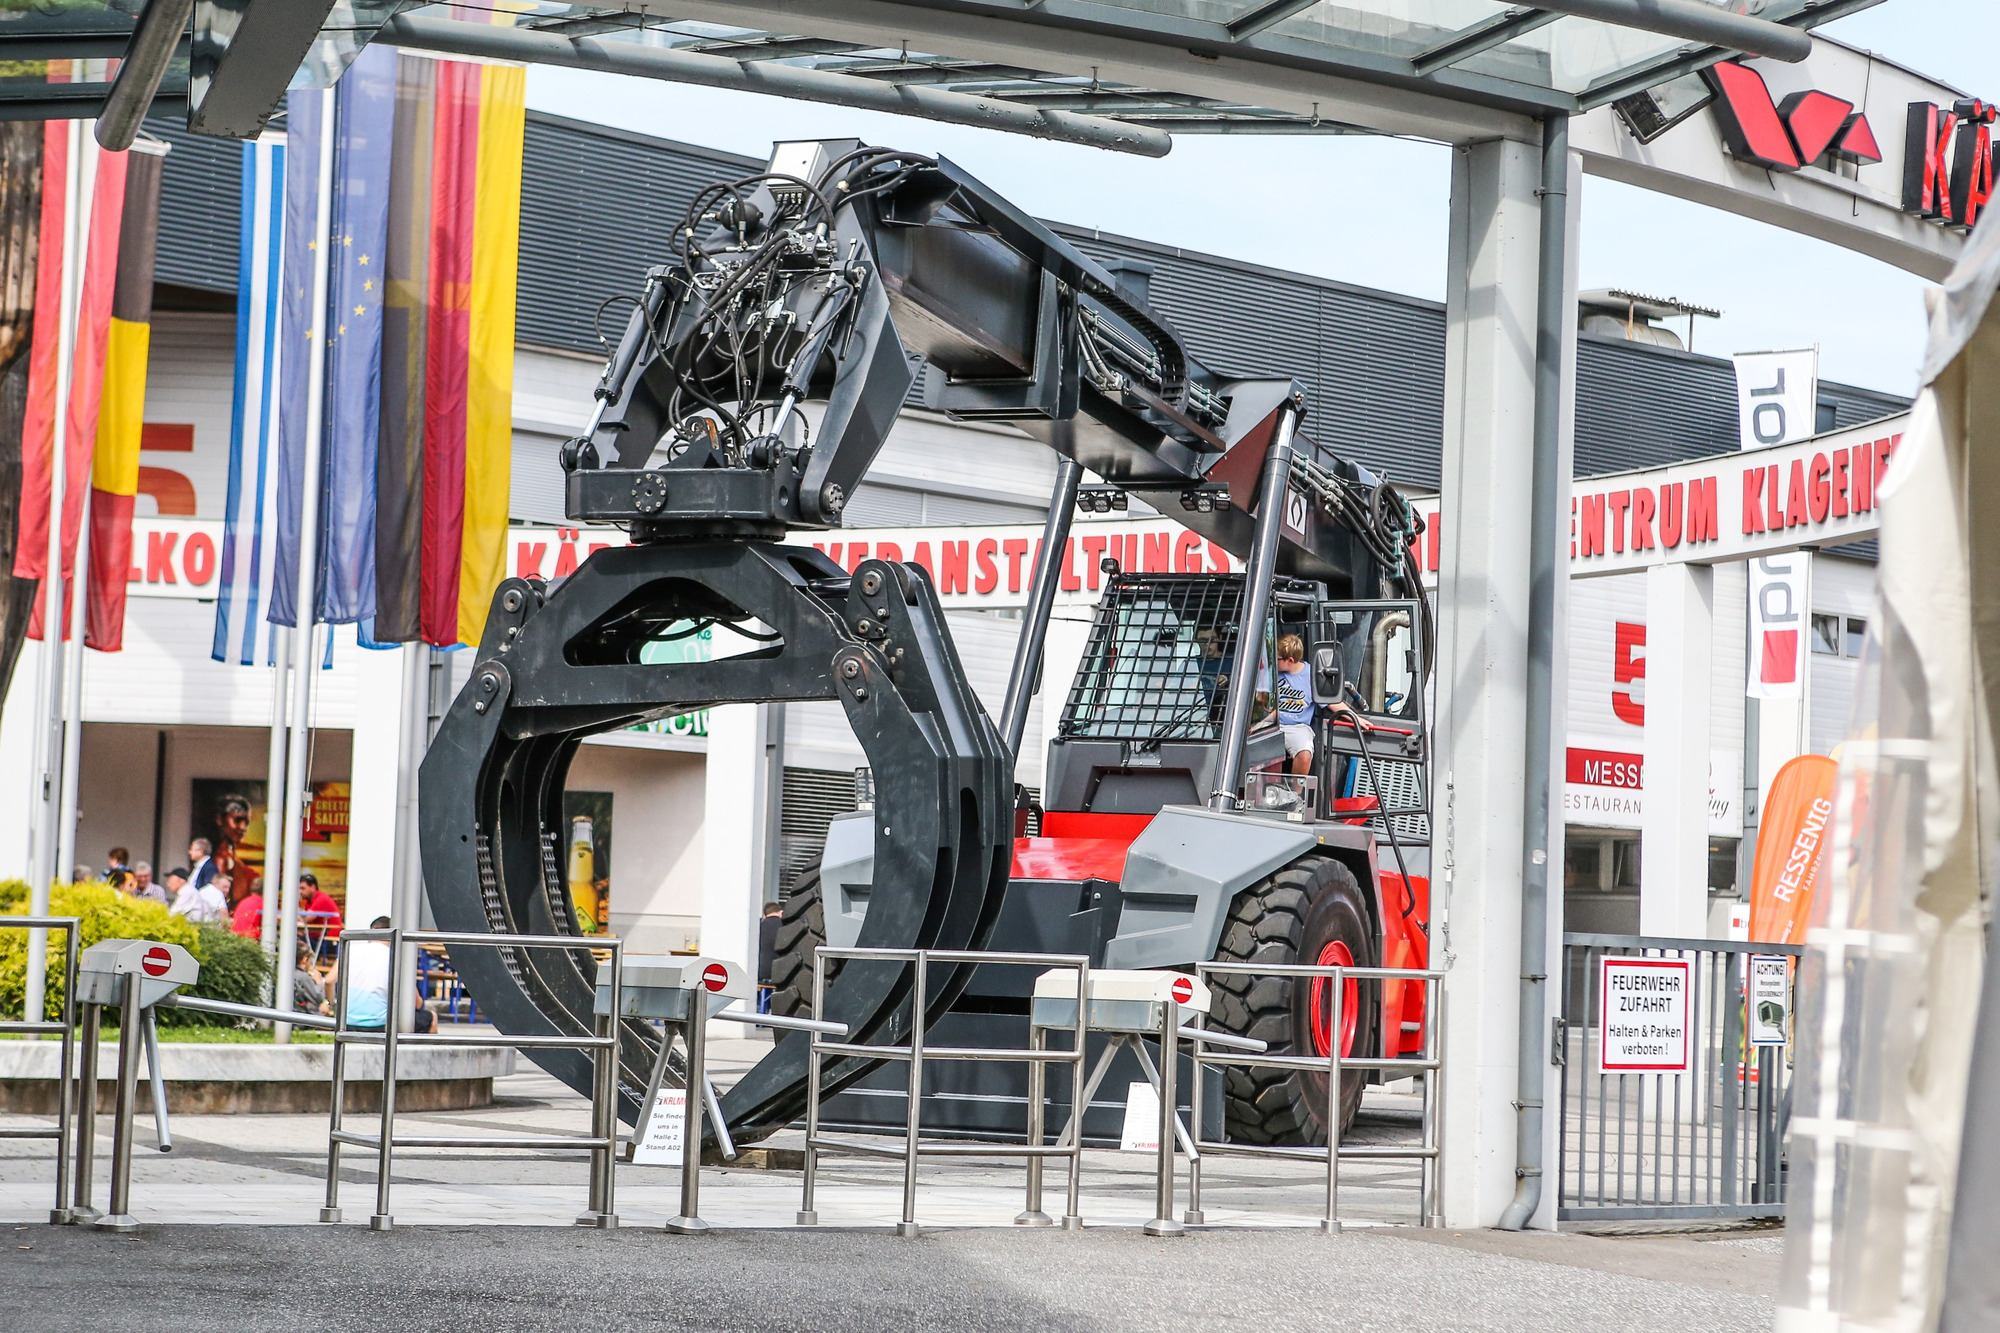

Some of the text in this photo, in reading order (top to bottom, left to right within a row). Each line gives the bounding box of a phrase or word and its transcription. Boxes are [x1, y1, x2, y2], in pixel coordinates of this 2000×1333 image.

[1742, 432, 1907, 535] KLAGENF
[1773, 797, 1833, 903] RESSENIG
[1612, 974, 1681, 992] FEUERWEHR
[1620, 996, 1672, 1013] ZUFAHRT
[1608, 1024, 1682, 1039] Halten & Parken
[645, 1143, 666, 1151] Stand
